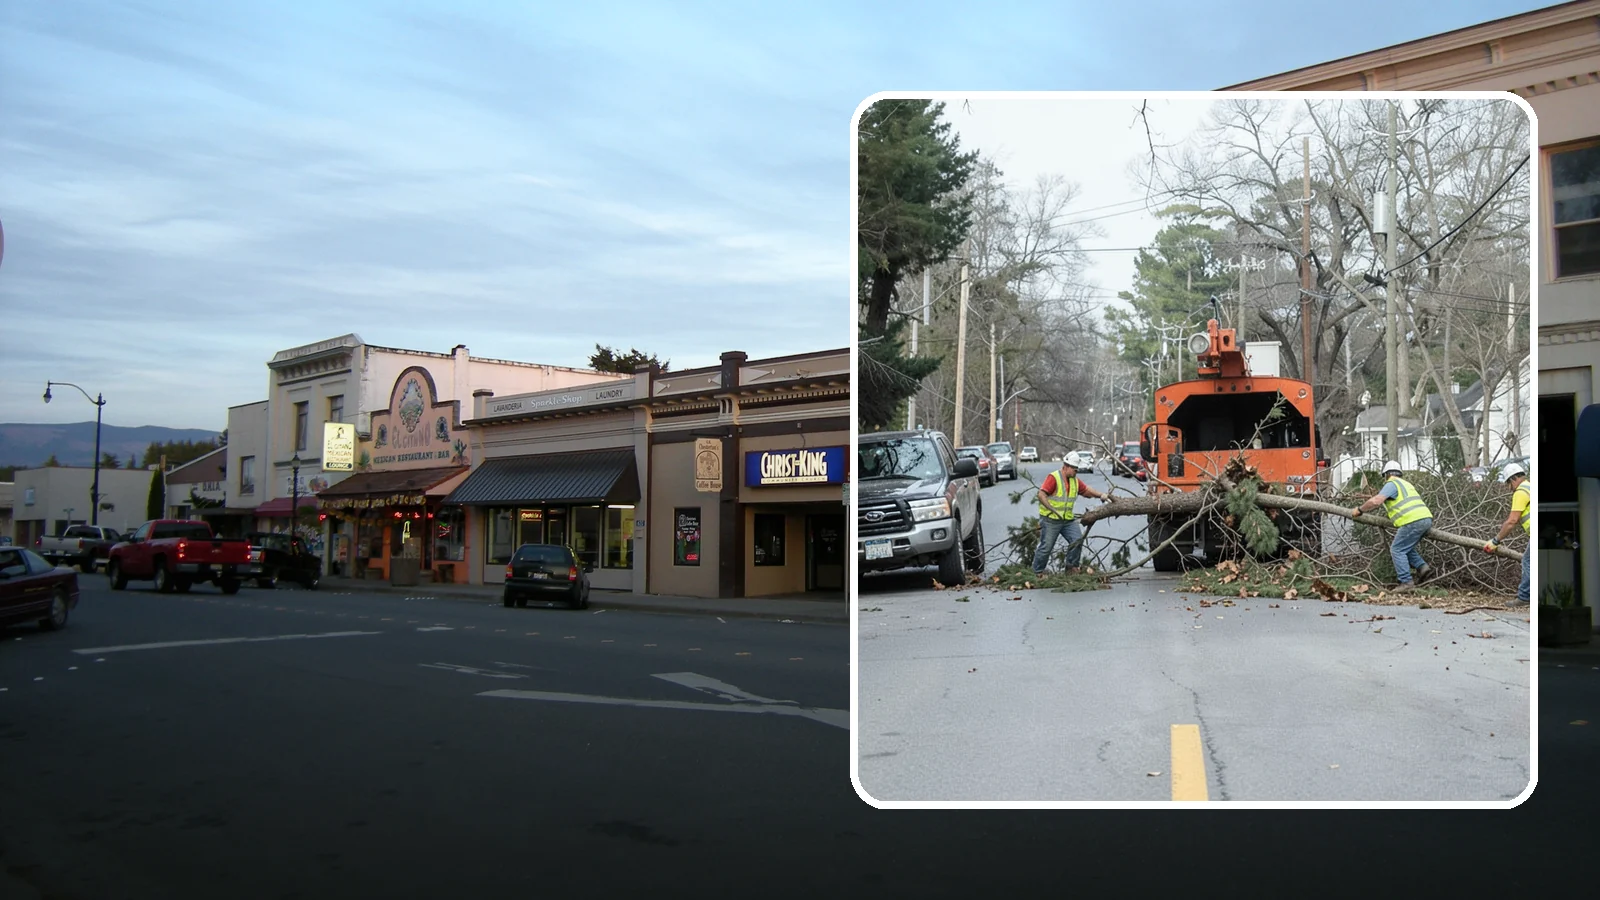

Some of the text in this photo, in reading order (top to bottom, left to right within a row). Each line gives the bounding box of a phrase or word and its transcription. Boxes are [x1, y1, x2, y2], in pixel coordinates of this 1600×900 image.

[530, 394, 583, 409] Sparkle Shop
[595, 389, 623, 400] LAUNDRY
[493, 402, 522, 413] LAVANDERIA
[373, 455, 396, 464] MEXICAN
[397, 452, 433, 462] RESTAURANT
[438, 450, 450, 460] BAR
[761, 450, 827, 478] CHRIST KING
